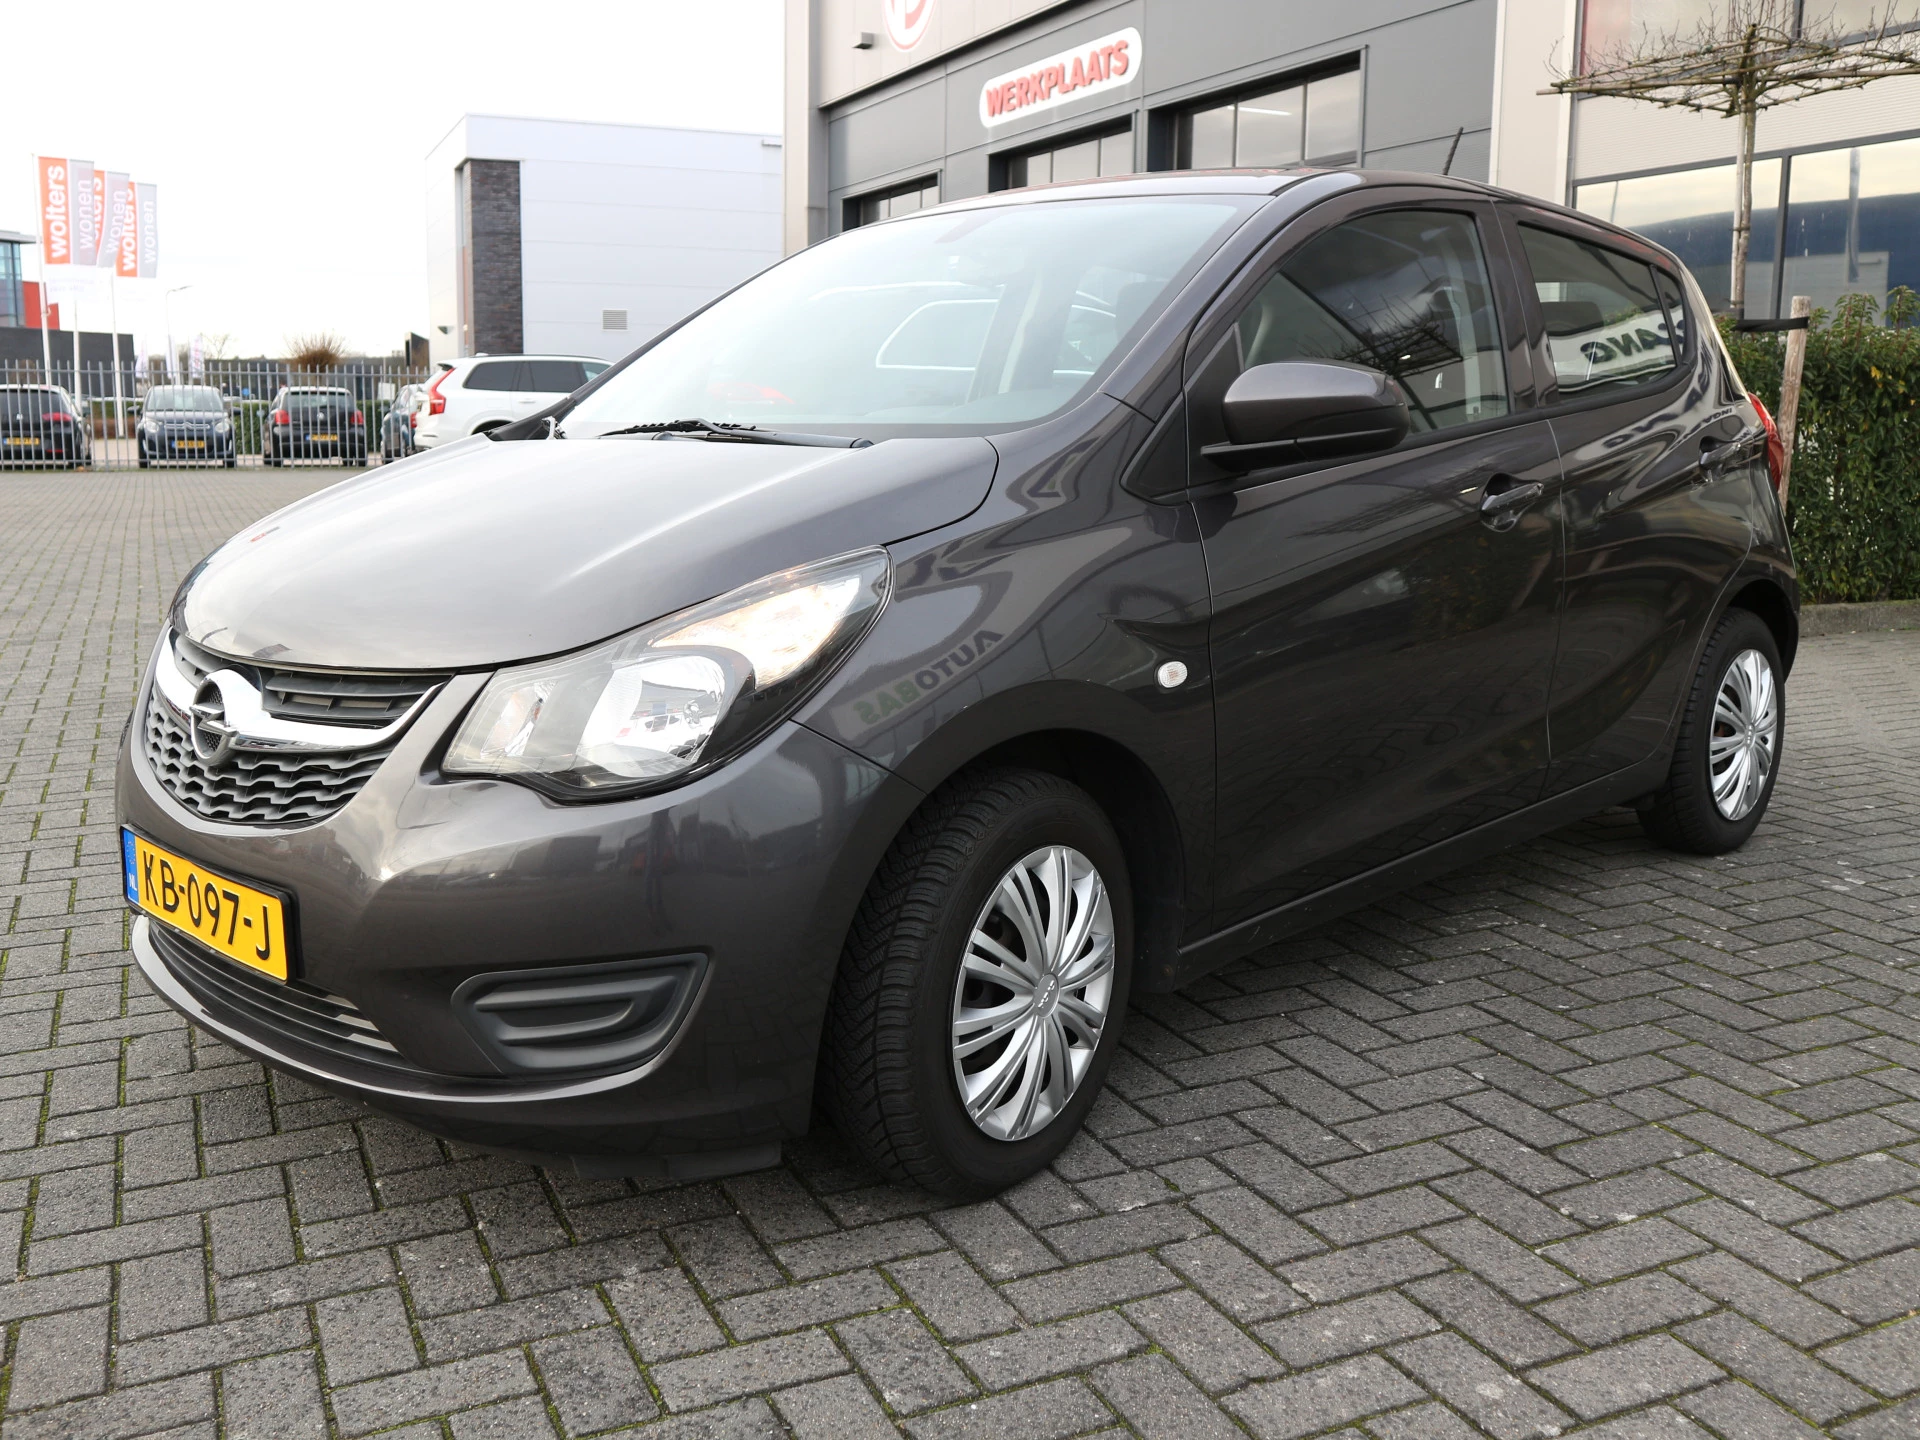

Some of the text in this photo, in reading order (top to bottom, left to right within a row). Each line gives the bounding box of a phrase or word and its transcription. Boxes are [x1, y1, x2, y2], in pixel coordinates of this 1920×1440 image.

[986, 40, 1129, 117] WERKPLAATS
[45, 165, 67, 258] wolters
[78, 179, 94, 250] wonen
[106, 190, 127, 254] wonen
[143, 200, 157, 264] wonen
[128, 872, 138, 891] NL
[143, 850, 270, 960] KB-097-J
